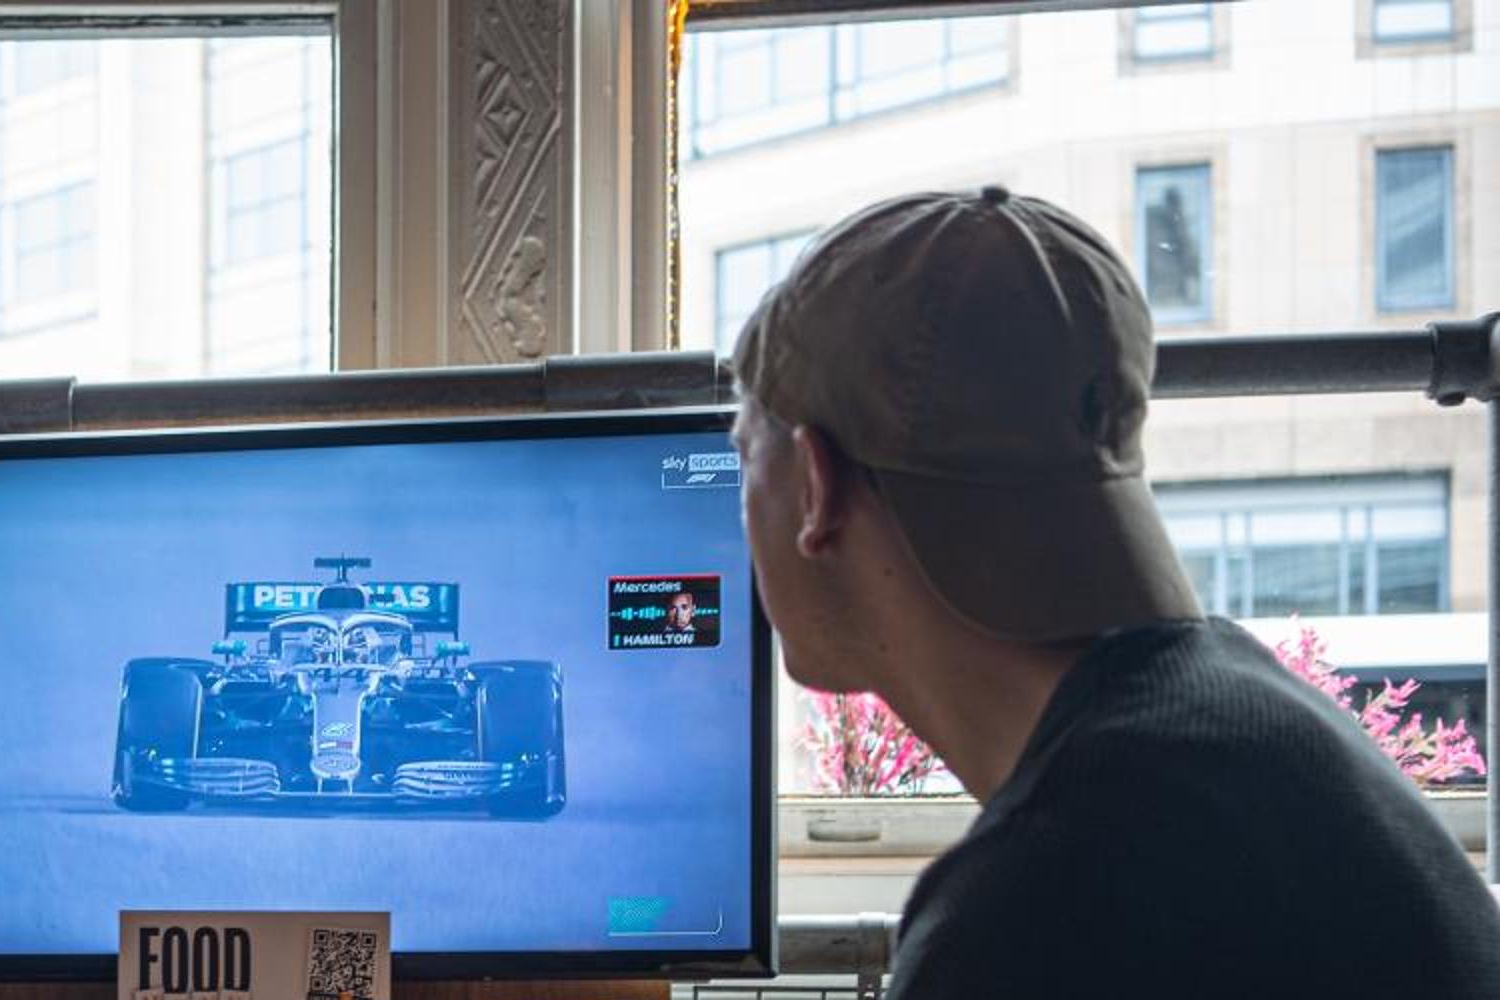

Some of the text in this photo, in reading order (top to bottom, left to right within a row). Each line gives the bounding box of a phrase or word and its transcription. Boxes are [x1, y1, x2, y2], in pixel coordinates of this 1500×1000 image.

[662, 455, 739, 471] sky sports
[613, 582, 681, 593] Mercedes
[623, 633, 695, 645] HAMILTON
[139, 926, 251, 993] FOOD
